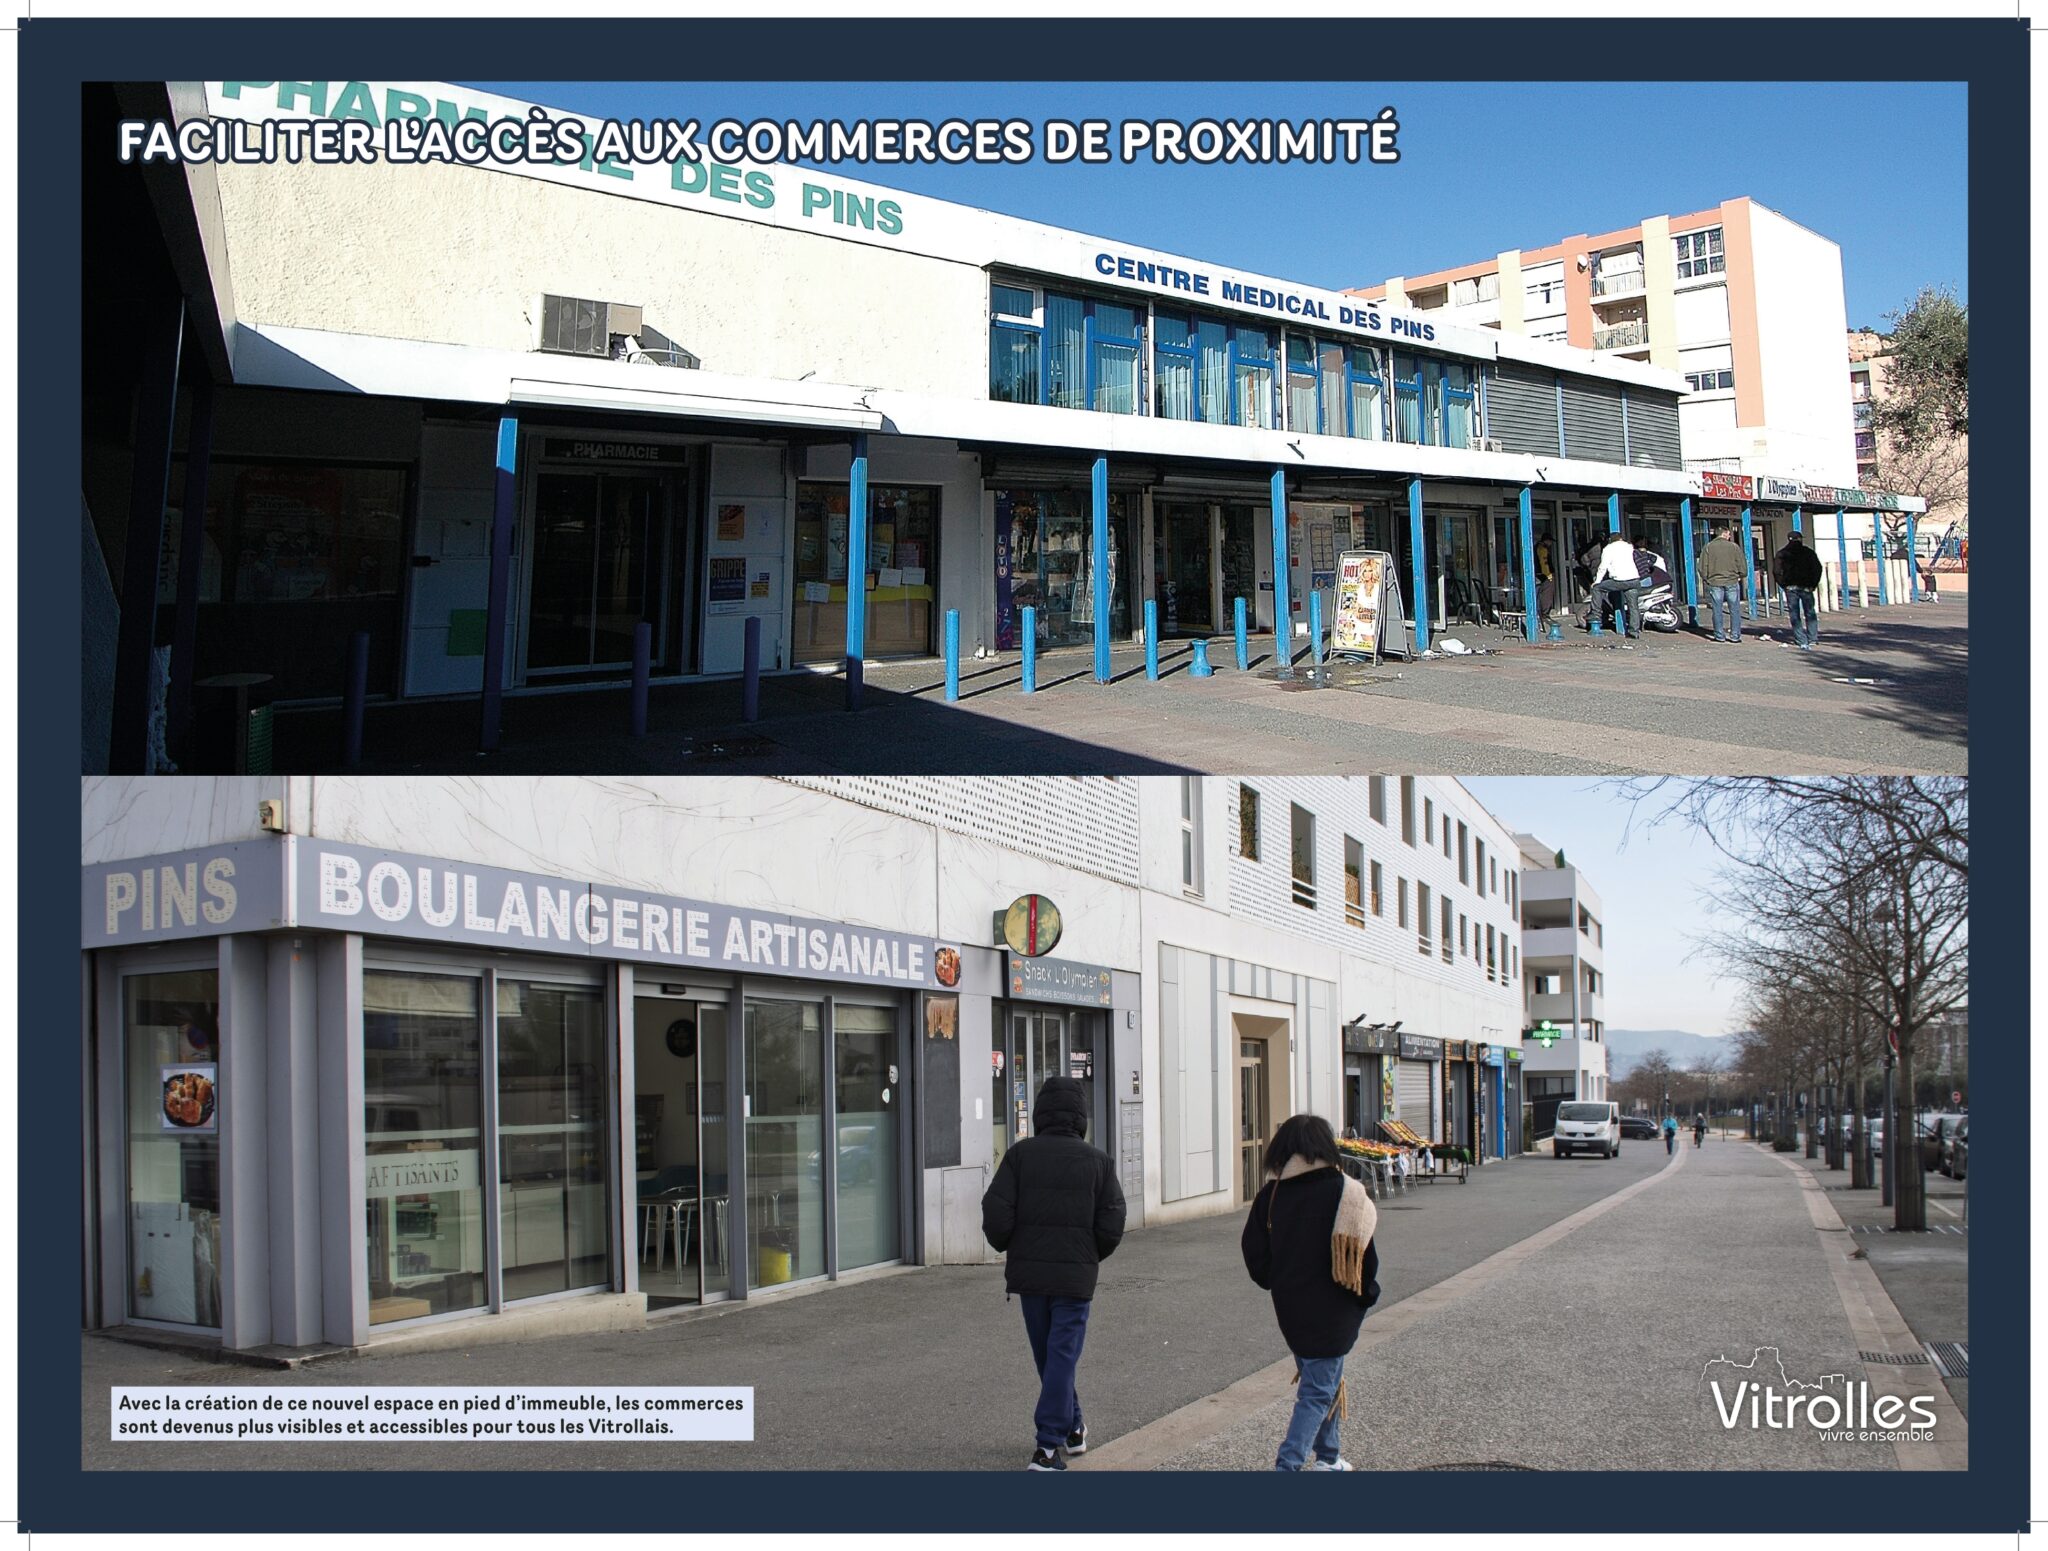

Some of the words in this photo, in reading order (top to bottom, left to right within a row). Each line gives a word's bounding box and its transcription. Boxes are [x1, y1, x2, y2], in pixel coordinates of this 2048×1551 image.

[671, 155, 775, 210] DES
[802, 183, 904, 236] PINS
[1095, 253, 1209, 296] CENTRE
[1222, 280, 1330, 320] MEDICAL
[1339, 306, 1382, 331] DES
[1390, 317, 1435, 341] PINS
[574, 442, 660, 460] PHARMACIE
[1699, 505, 1737, 516] BOUCHERIE
[711, 560, 745, 579] GRIPPE
[1344, 565, 1359, 578] HOT
[106, 857, 237, 935] PINS
[319, 852, 711, 958] BOULANGERIE
[722, 916, 925, 982] ARTISANALE
[1025, 961, 1052, 983] Snack
[1405, 1034, 1440, 1048] ALIMENTATION
